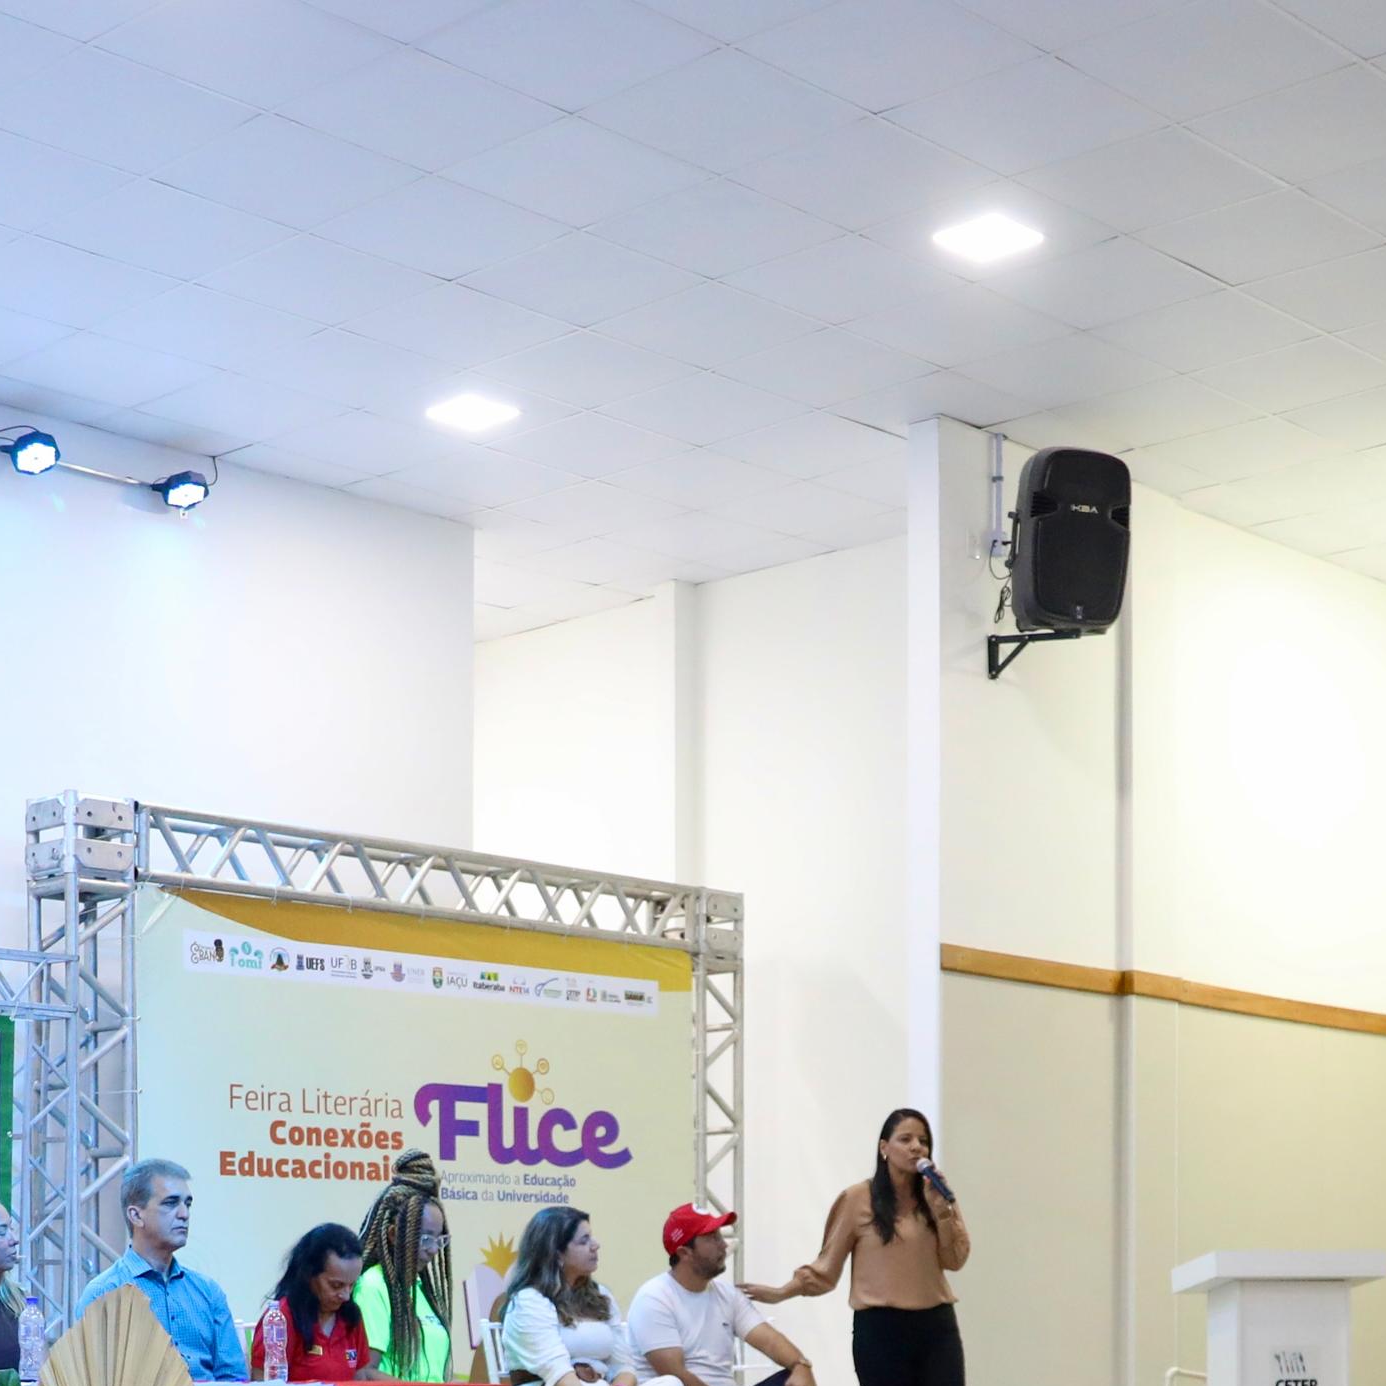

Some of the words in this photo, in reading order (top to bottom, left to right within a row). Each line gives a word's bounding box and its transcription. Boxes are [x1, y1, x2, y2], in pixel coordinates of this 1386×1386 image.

[306, 957, 325, 971] UEFS
[229, 1083, 292, 1113] Feira
[302, 1087, 404, 1119] Literária
[269, 1120, 404, 1150] Conexões
[414, 1082, 633, 1169] Flice
[219, 1150, 395, 1181] Educacionai
[441, 1170, 511, 1188] Aproximando
[514, 1177, 520, 1186] a
[523, 1174, 576, 1189] Educação
[441, 1187, 478, 1201] Básica
[481, 1189, 494, 1201] da
[497, 1190, 569, 1204] Universidade
